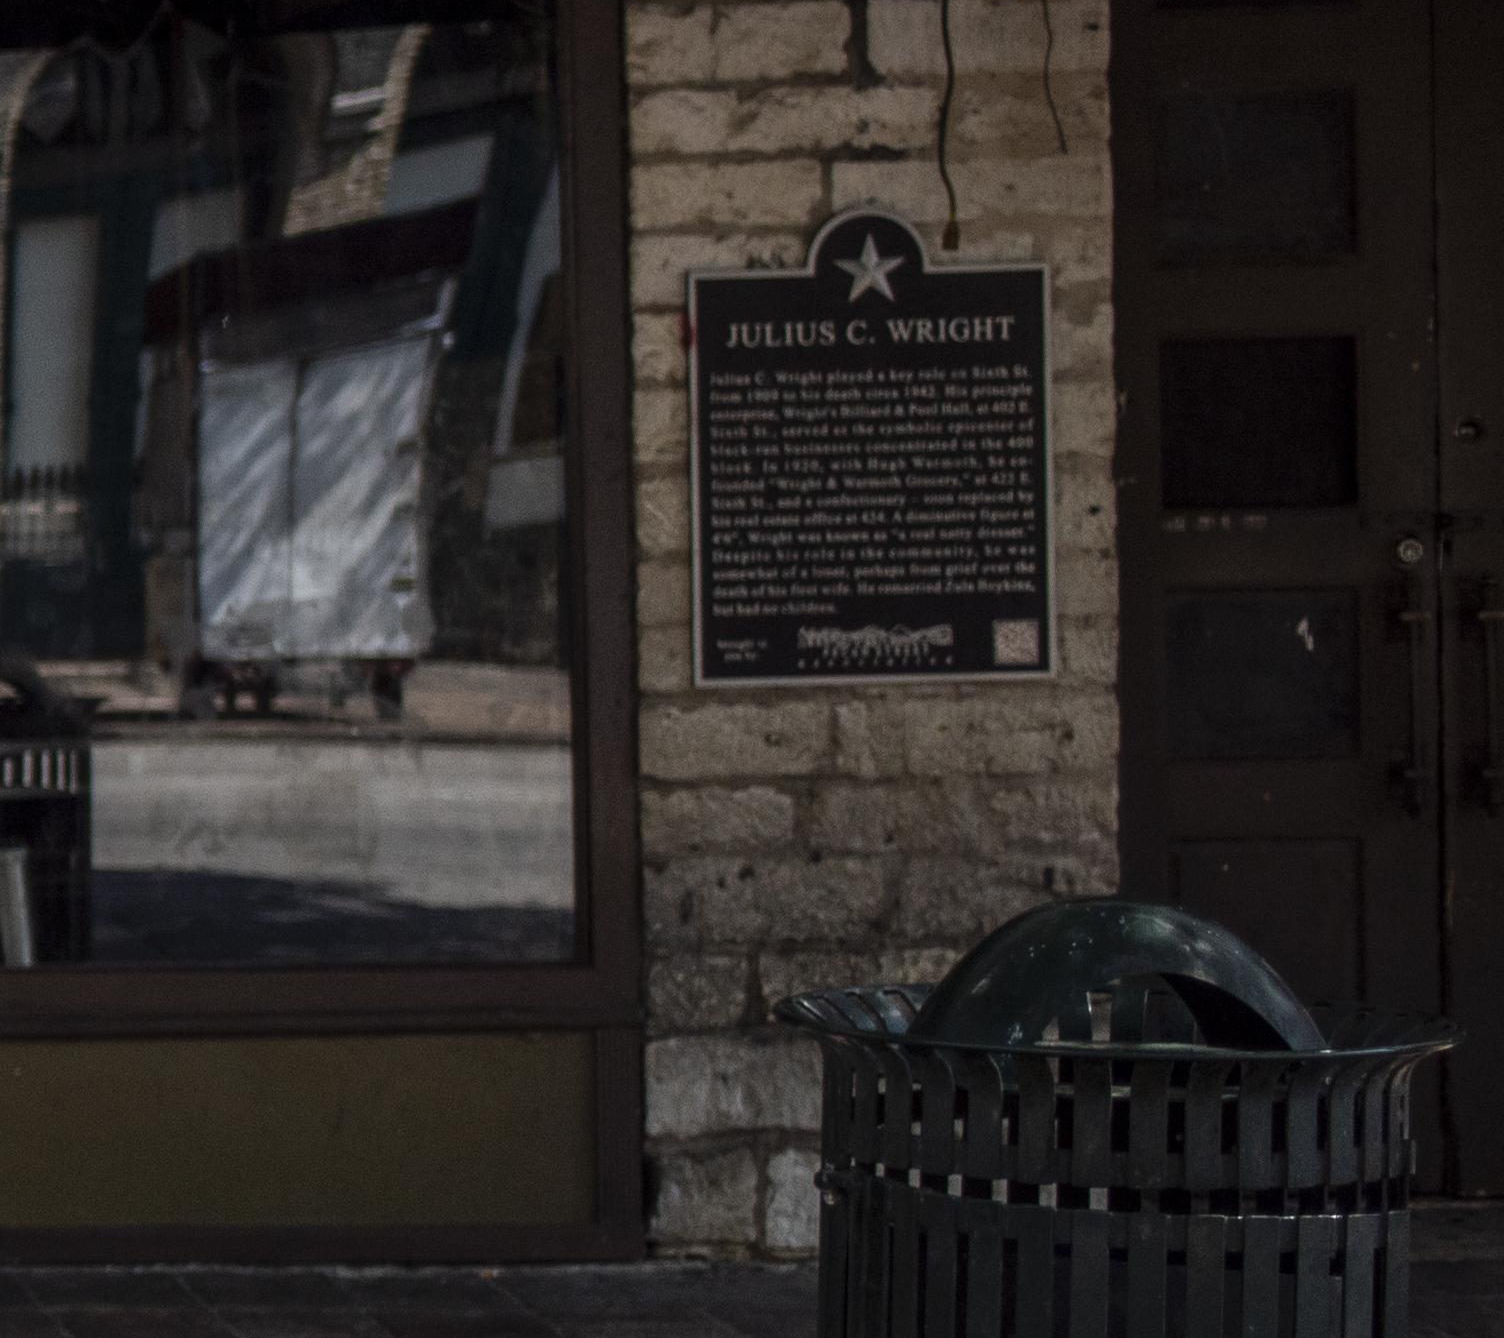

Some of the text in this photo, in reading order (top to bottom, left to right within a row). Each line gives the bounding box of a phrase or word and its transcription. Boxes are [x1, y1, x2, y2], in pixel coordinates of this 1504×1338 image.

[725, 316, 1016, 349] JULIUS C. WRIGHT
